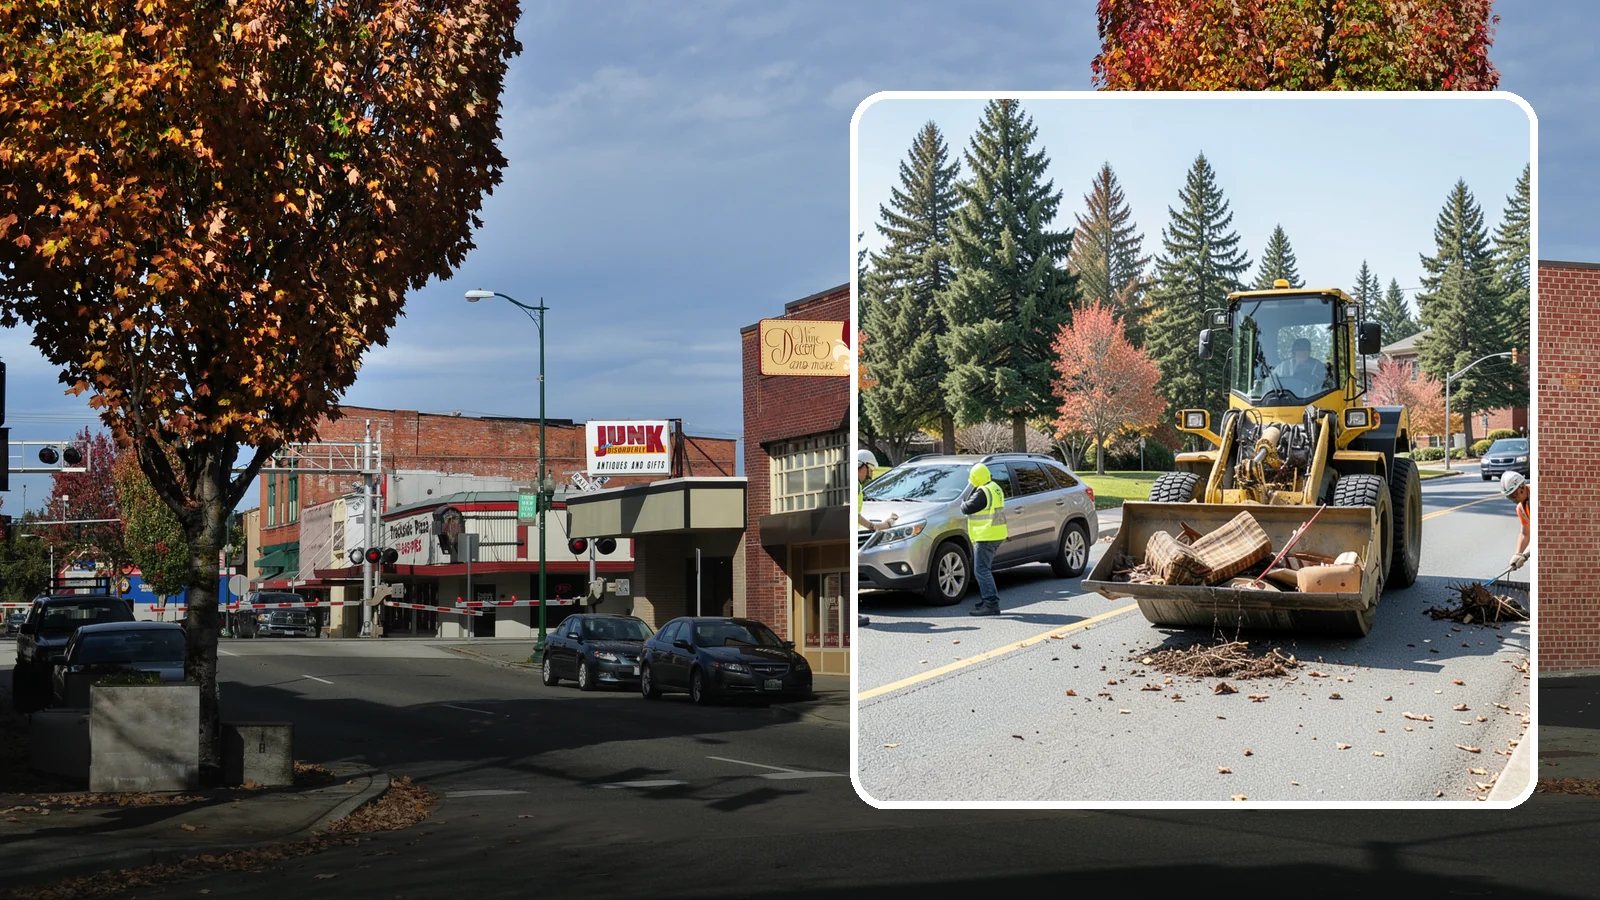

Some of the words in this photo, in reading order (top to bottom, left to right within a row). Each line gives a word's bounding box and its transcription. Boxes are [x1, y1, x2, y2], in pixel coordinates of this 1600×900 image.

[595, 425, 665, 457] JUNK
[607, 446, 646, 454] DISORDERLY
[597, 461, 628, 470] ANTIQUES
[631, 461, 644, 470] AND
[647, 460, 665, 470] GIFTS
[390, 523, 413, 540] Trackside
[414, 519, 429, 535] Pizza
